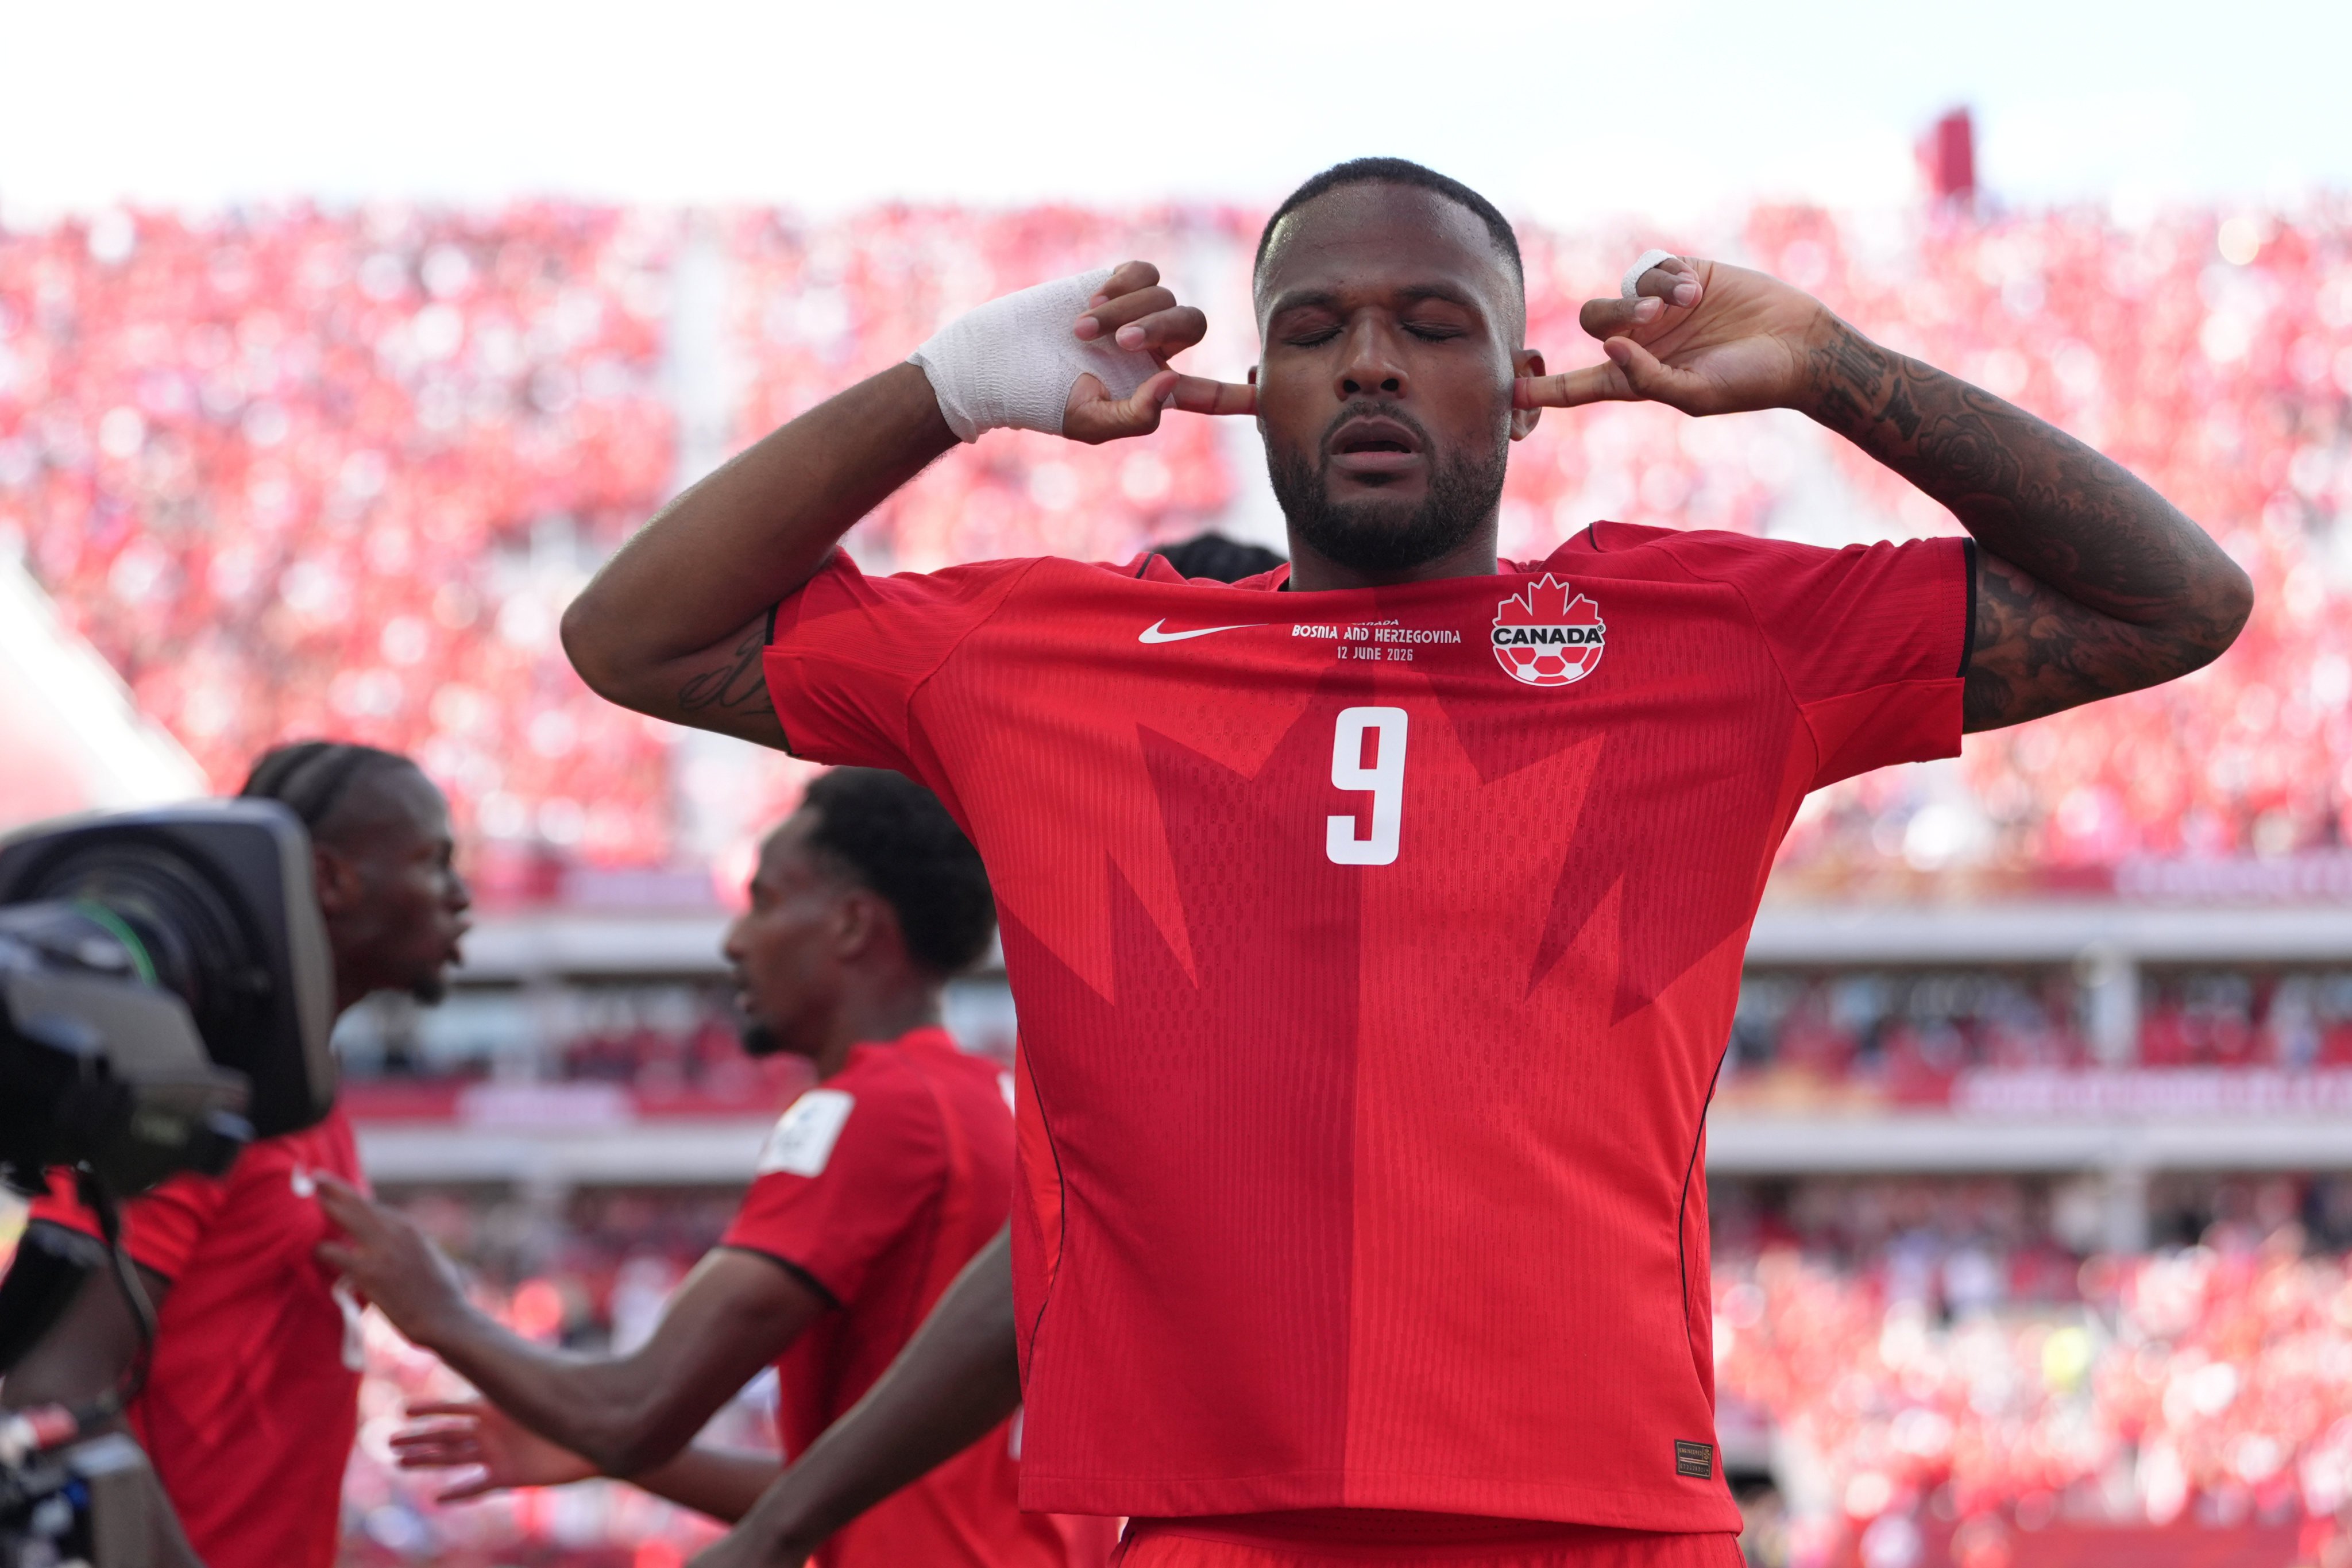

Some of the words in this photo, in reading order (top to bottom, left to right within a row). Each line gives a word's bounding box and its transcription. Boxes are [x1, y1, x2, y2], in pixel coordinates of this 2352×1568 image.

[1292, 624, 1338, 639] BOSNIA
[1343, 627, 1369, 641] AND
[1374, 629, 1462, 643] HERZEGOVINA
[1493, 628, 1602, 645] CANADA
[1337, 646, 1347, 659] 12
[1353, 647, 1381, 660] JUNE
[1387, 648, 1413, 661] 2026
[1326, 706, 1408, 866] 9
